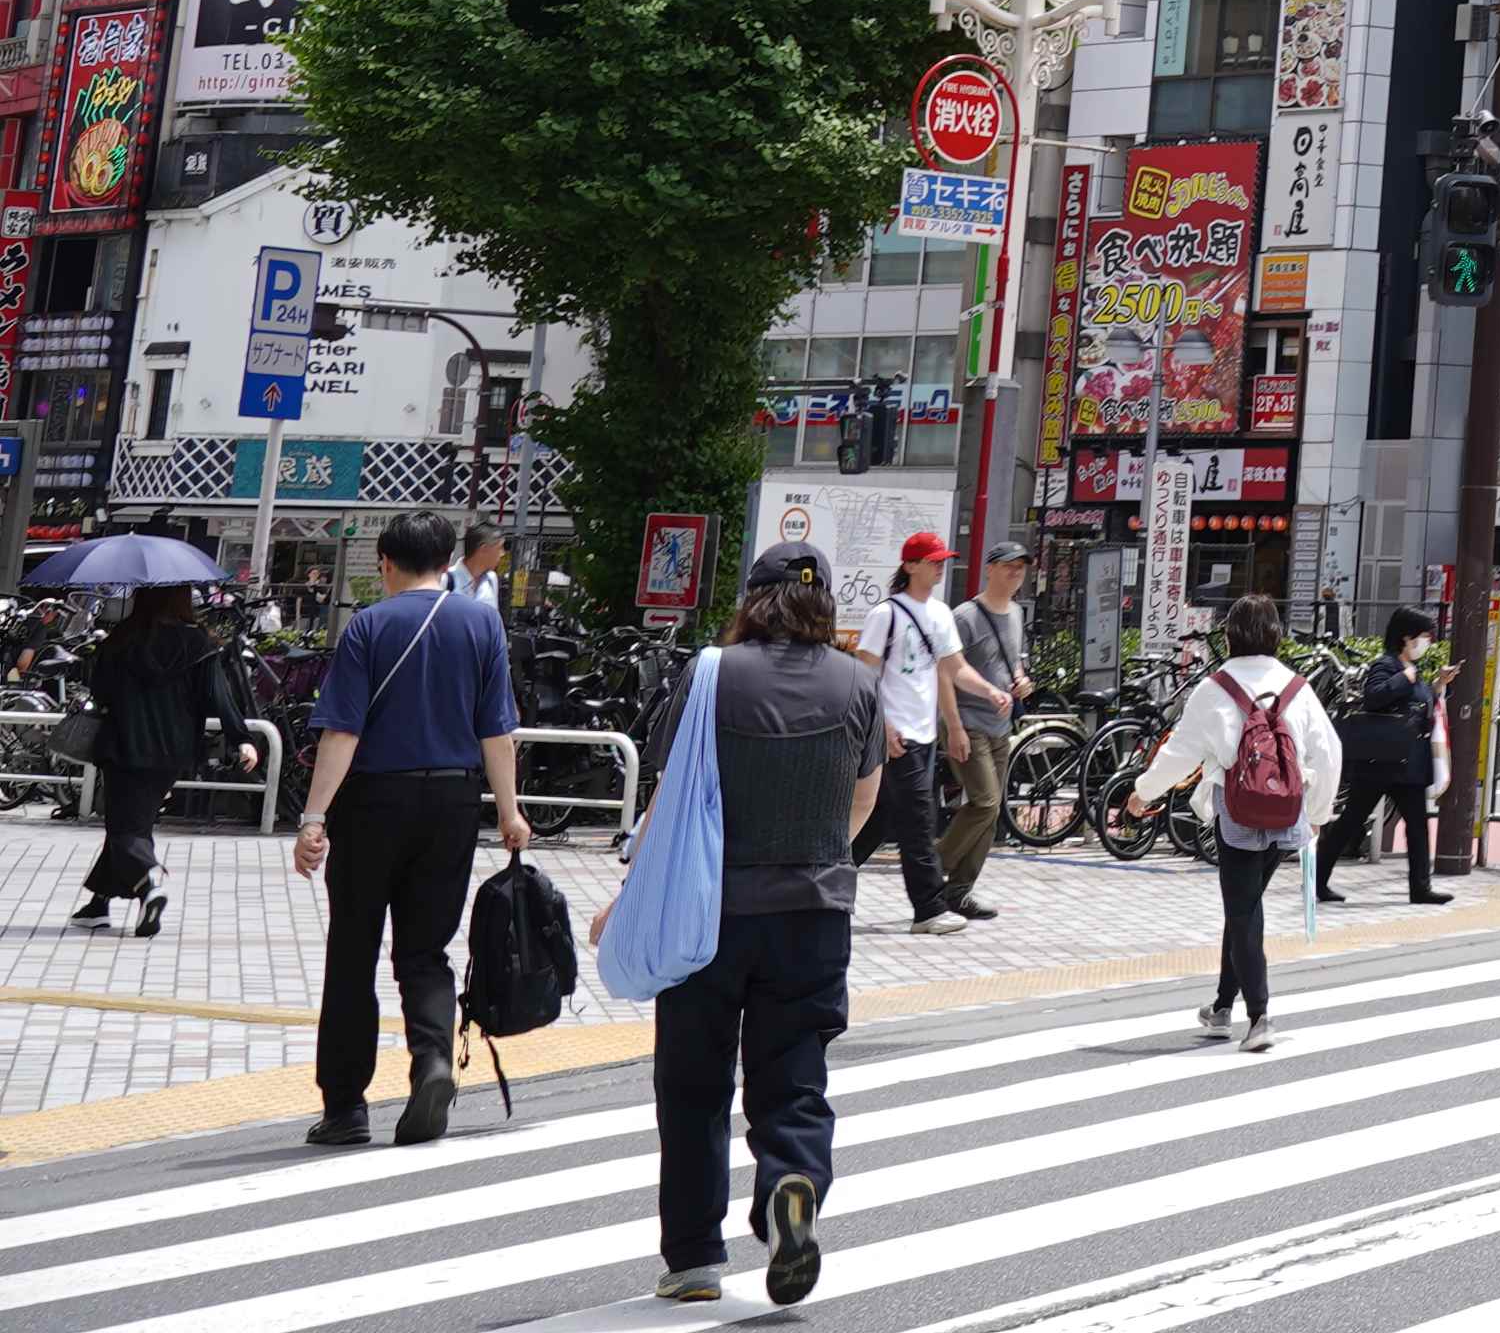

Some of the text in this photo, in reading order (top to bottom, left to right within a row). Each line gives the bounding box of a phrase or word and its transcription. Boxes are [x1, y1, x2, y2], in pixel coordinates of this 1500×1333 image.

[932, 96, 997, 139] 消火栓
[260, 258, 302, 323] P
[275, 304, 309, 325] 24H
[308, 360, 365, 376] GARI
[1145, 469, 1172, 640] ゆっくり通行しましょう
